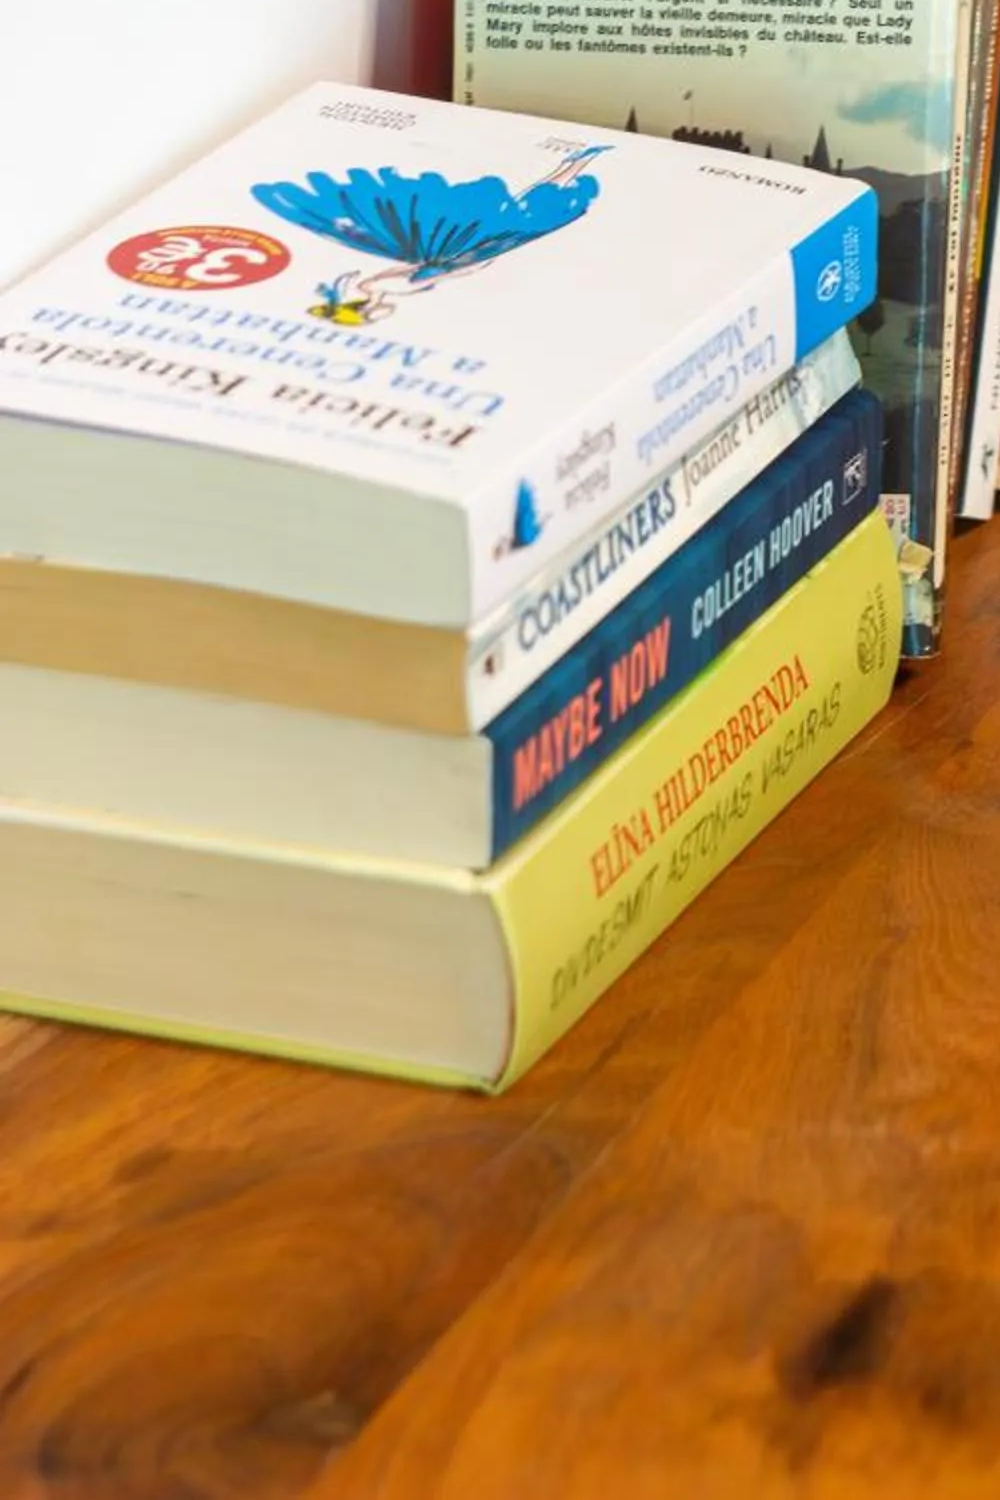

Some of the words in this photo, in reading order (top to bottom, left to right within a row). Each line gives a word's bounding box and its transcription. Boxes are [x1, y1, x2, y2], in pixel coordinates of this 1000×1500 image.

[485, 0, 543, 16] miracle
[546, 1, 581, 20] peut
[584, 5, 636, 18] sauver
[639, 4, 654, 19] la
[657, 4, 703, 20] vieille
[781, 8, 838, 24] miracle
[841, 13, 872, 29] que
[875, 11, 914, 30] Lady
[485, 35, 519, 50] folle
[524, 39, 544, 51] ou
[549, 36, 572, 52] les
[576, 37, 647, 54] fantômes
[651, 39, 734, 56] existent-ils
[486, 17, 524, 36] Mary
[531, 18, 590, 38] implore
[596, 23, 624, 36] aux
[630, 21, 673, 37] hôtes
[679, 23, 750, 39] invisibles
[756, 25, 777, 40] du
[855, 28, 913, 44] Est-elle
[0, 330, 248, 397] Kingsley
[31, 306, 368, 384] Cenerentola
[117, 292, 439, 370] Manhattan
[451, 355, 487, 372] a
[273, 384, 481, 449] Felicia
[387, 373, 505, 418] Una
[517, 476, 676, 651] COASTLINERS
[679, 421, 743, 508] Joanne
[743, 366, 802, 436] Harris
[512, 678, 604, 810] MAYBE
[610, 615, 672, 722] NOW
[690, 546, 767, 640] COLLEEN
[768, 478, 836, 570] HOOVER
[652, 654, 811, 834] HILDERBRENDA
[760, 681, 842, 795] VASARAS
